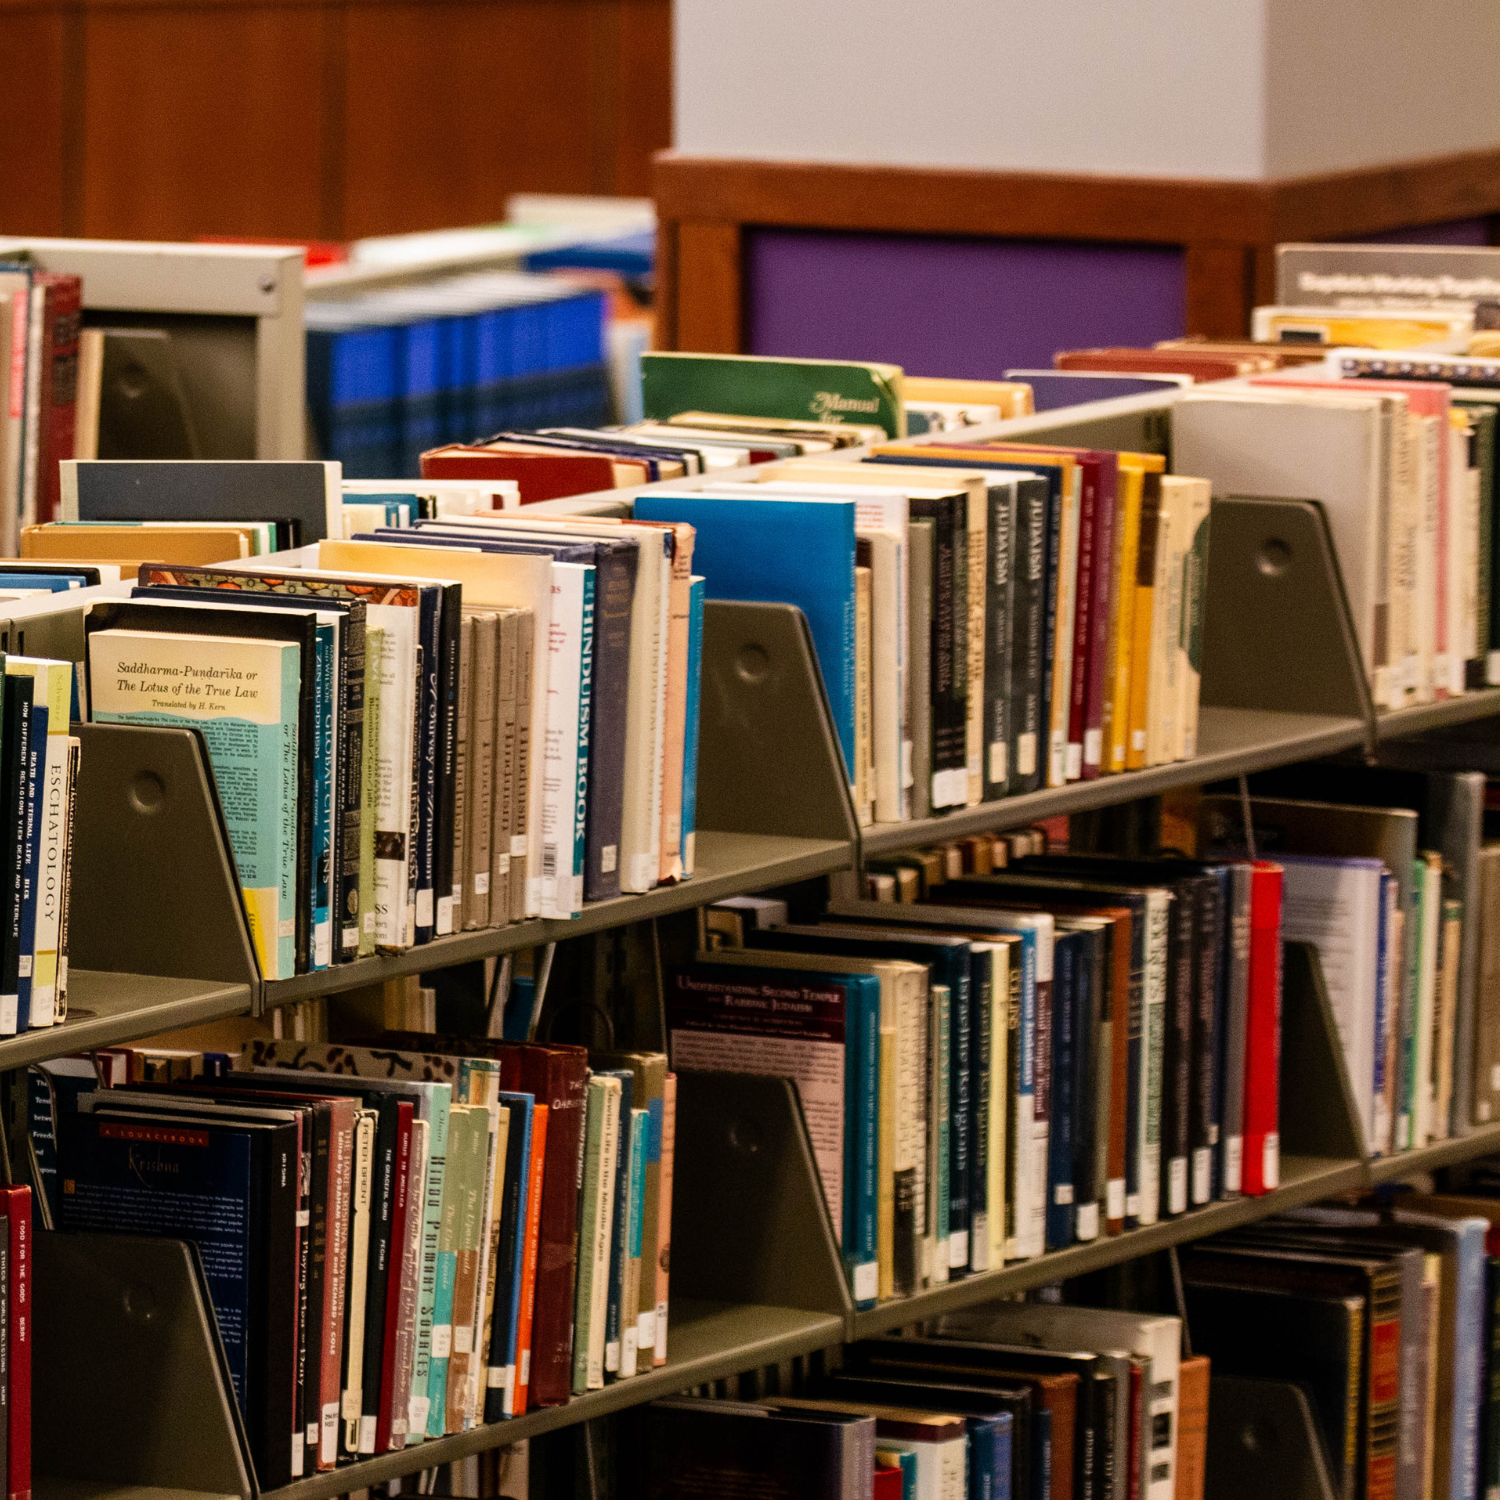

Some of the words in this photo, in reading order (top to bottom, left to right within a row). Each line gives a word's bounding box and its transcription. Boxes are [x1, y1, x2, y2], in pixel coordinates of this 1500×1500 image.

[996, 503, 1008, 585] JUDAISM
[1030, 498, 1043, 580] JUDAISM
[117, 680, 136, 691] The
[140, 681, 168, 693] Lotus
[172, 683, 183, 696] of
[186, 684, 201, 695] the
[205, 685, 231, 696] True
[235, 686, 258, 698] Law
[246, 672, 258, 680] or
[578, 602, 594, 748] HINDUISM
[152, 699, 187, 709] Translated
[189, 702, 196, 710] by
[209, 703, 226, 711] Kern
[20, 722, 28, 766] DIFFERENT
[282, 724, 289, 738] or
[29, 751, 37, 778] DEATH
[282, 739, 290, 764] The
[18, 770, 26, 815] RELIGIONS
[28, 782, 36, 798] AND
[281, 769, 290, 801] Lotus
[575, 757, 588, 842] BOOK
[26, 802, 34, 839] ETERNAL
[281, 803, 290, 815] of
[282, 818, 290, 837] the
[15, 844, 23, 870] DEATH
[43, 764, 61, 922] ESCHATOLOGY
[281, 839, 290, 868] True
[281, 873, 289, 900] Law
[12, 893, 20, 938] AFTERLIFE
[802, 989, 840, 1003] TEMPLE
[436, 1109, 445, 1143] Olson
[336, 1131, 344, 1157] Edited
[360, 1124, 370, 1163] PETER
[333, 1158, 342, 1173] by
[604, 1157, 611, 1169] in
[359, 1167, 368, 1206] BRENT
[427, 1156, 445, 1208] HINDU
[334, 1177, 343, 1219] GRAHAM
[600, 1192, 608, 1230] Middle
[332, 1223, 341, 1253] DWYER
[598, 1233, 606, 1262] Ages
[332, 1256, 340, 1274] and
[422, 1221, 441, 1294] PRIMARY
[331, 1277, 339, 1318] RICHARD
[330, 1321, 337, 1329] J.
[416, 1306, 439, 1378] SOURCES
